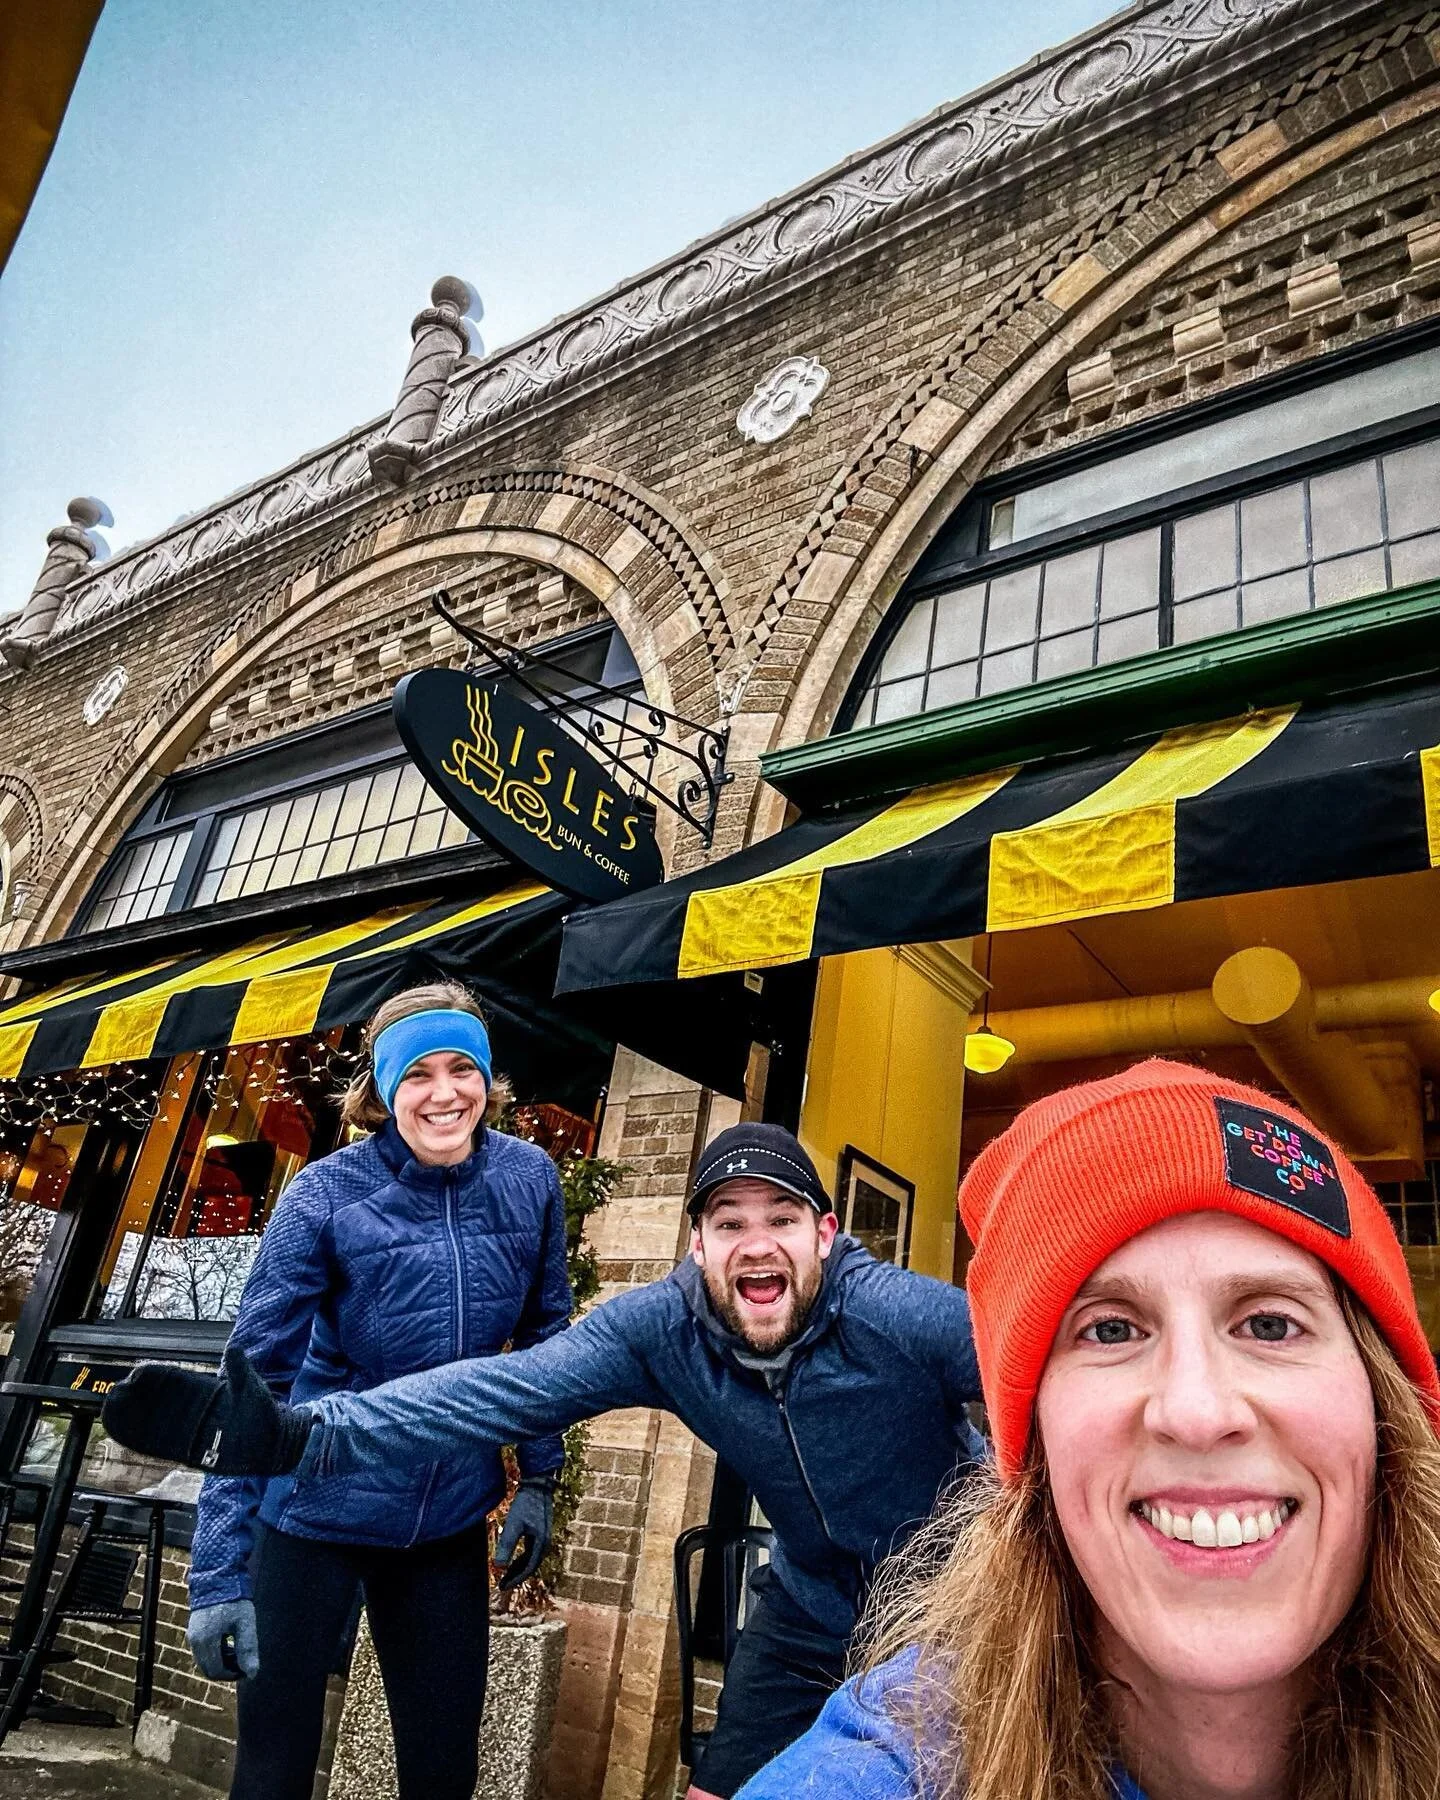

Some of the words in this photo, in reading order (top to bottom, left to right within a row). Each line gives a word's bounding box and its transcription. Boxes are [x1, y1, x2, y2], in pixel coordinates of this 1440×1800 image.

[509, 725, 639, 850] ISLES
[557, 824, 582, 850] BUN
[583, 843, 593, 859] &
[594, 853, 632, 885] COFFEE
[1226, 1122, 1266, 1143] GET
[1271, 1136, 1336, 1179] DOWN
[1263, 1120, 1302, 1147] THE
[1251, 1144, 1325, 1186] COFFEE
